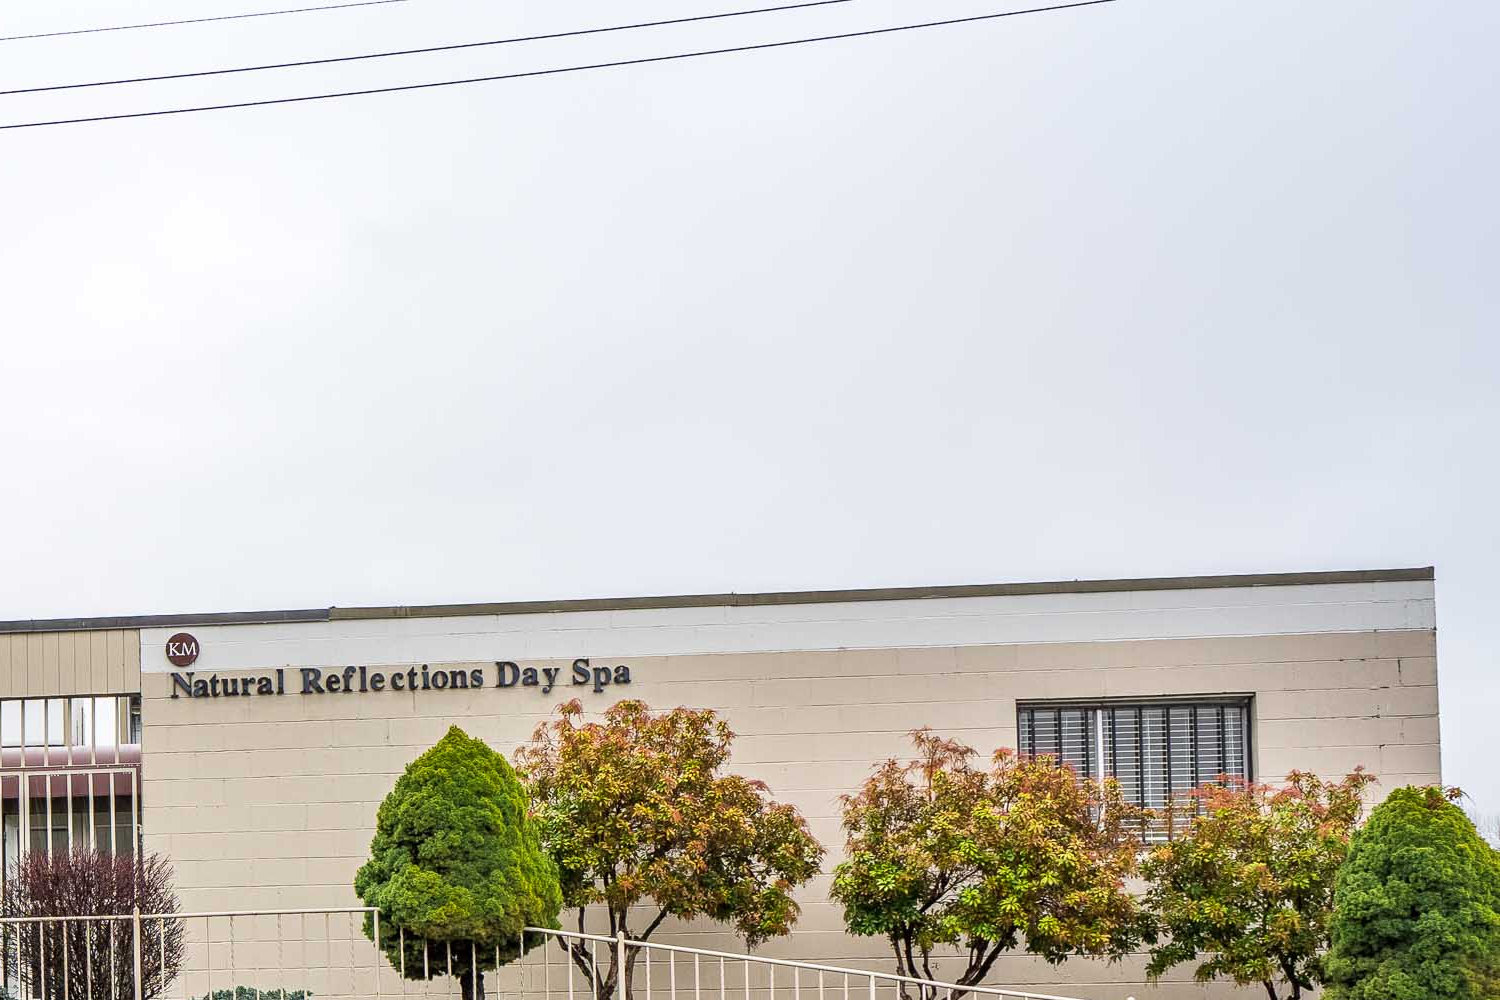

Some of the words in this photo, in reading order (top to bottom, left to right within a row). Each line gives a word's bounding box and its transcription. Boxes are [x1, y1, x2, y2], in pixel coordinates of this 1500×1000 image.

[168, 642, 197, 657] KM
[170, 669, 284, 698] Natural
[300, 664, 484, 695] Reflections
[495, 661, 560, 694] Day
[572, 658, 632, 693] Spa
